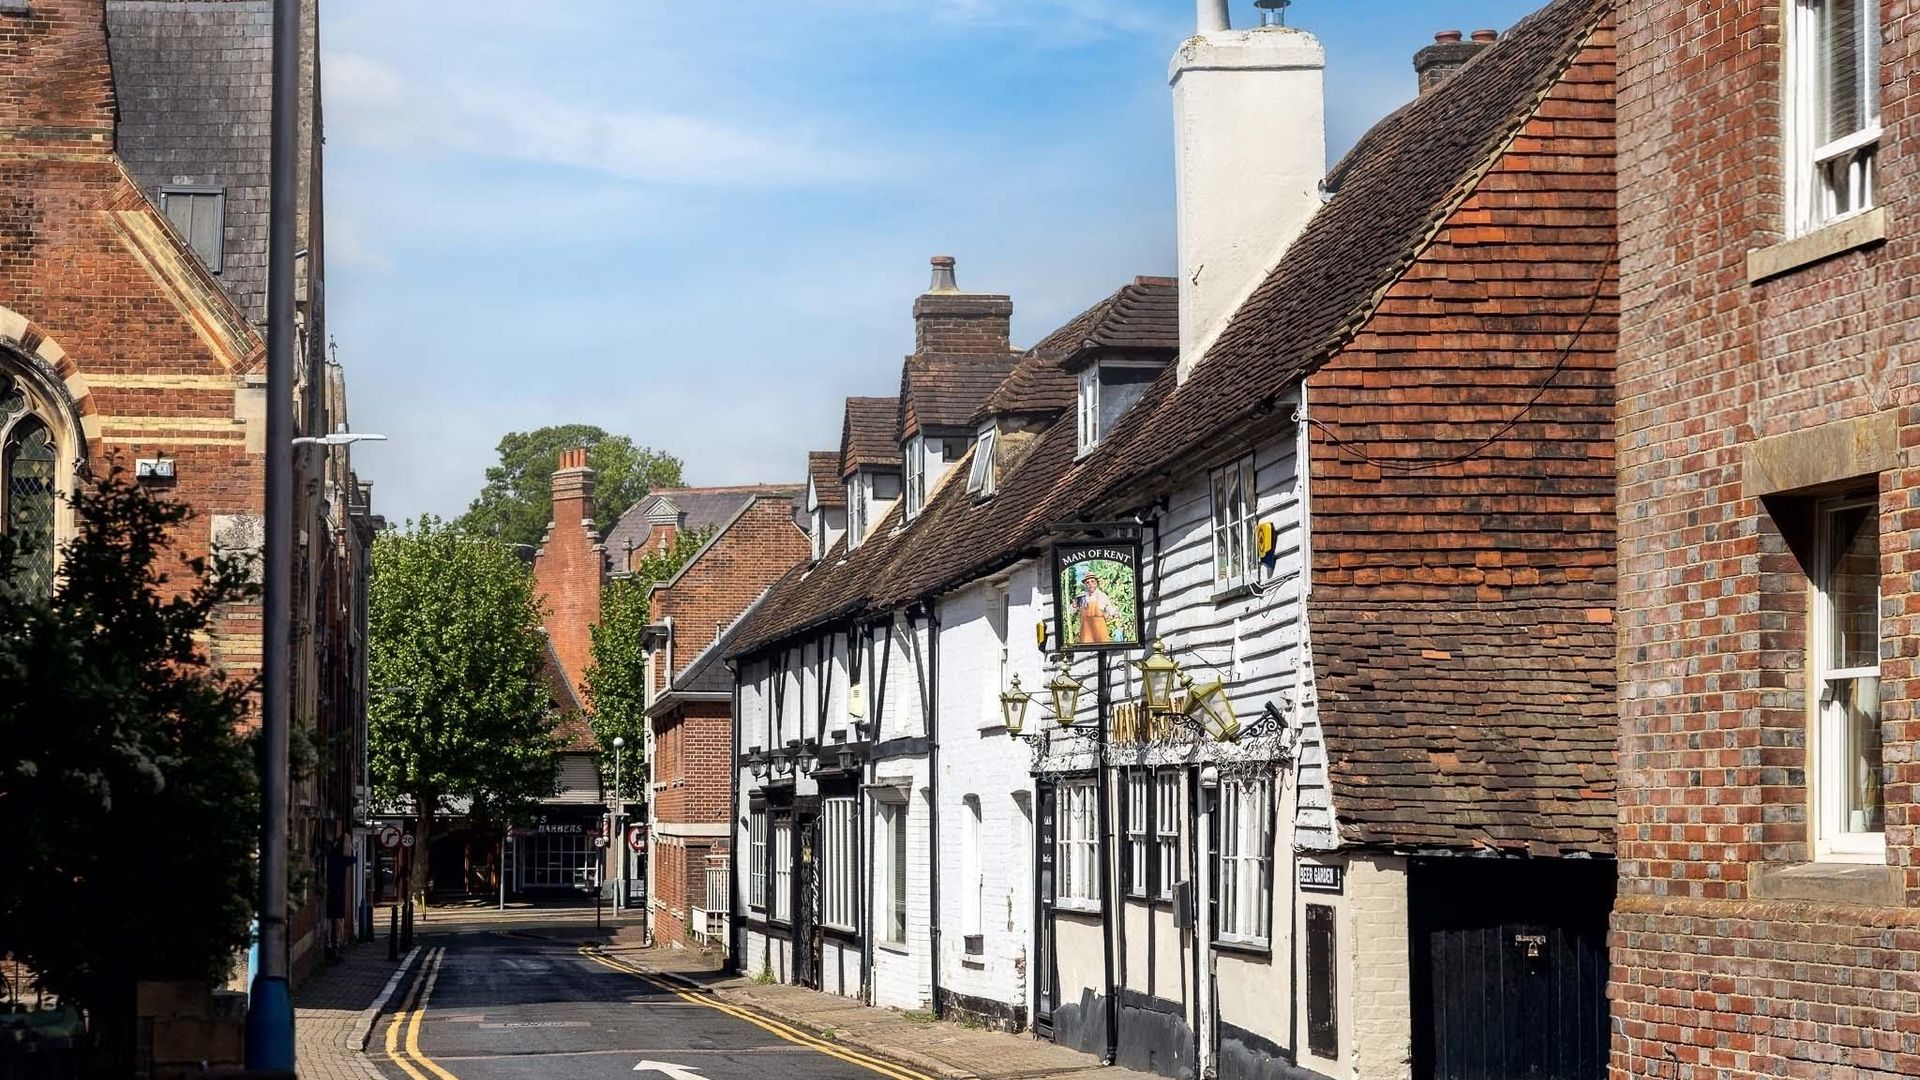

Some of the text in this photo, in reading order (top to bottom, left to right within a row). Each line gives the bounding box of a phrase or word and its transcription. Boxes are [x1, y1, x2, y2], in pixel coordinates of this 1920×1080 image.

[1062, 549, 1131, 565] MAN OF KENT
[538, 824, 582, 833] BARBERS
[1300, 867, 1334, 884] BEER GARDEN
